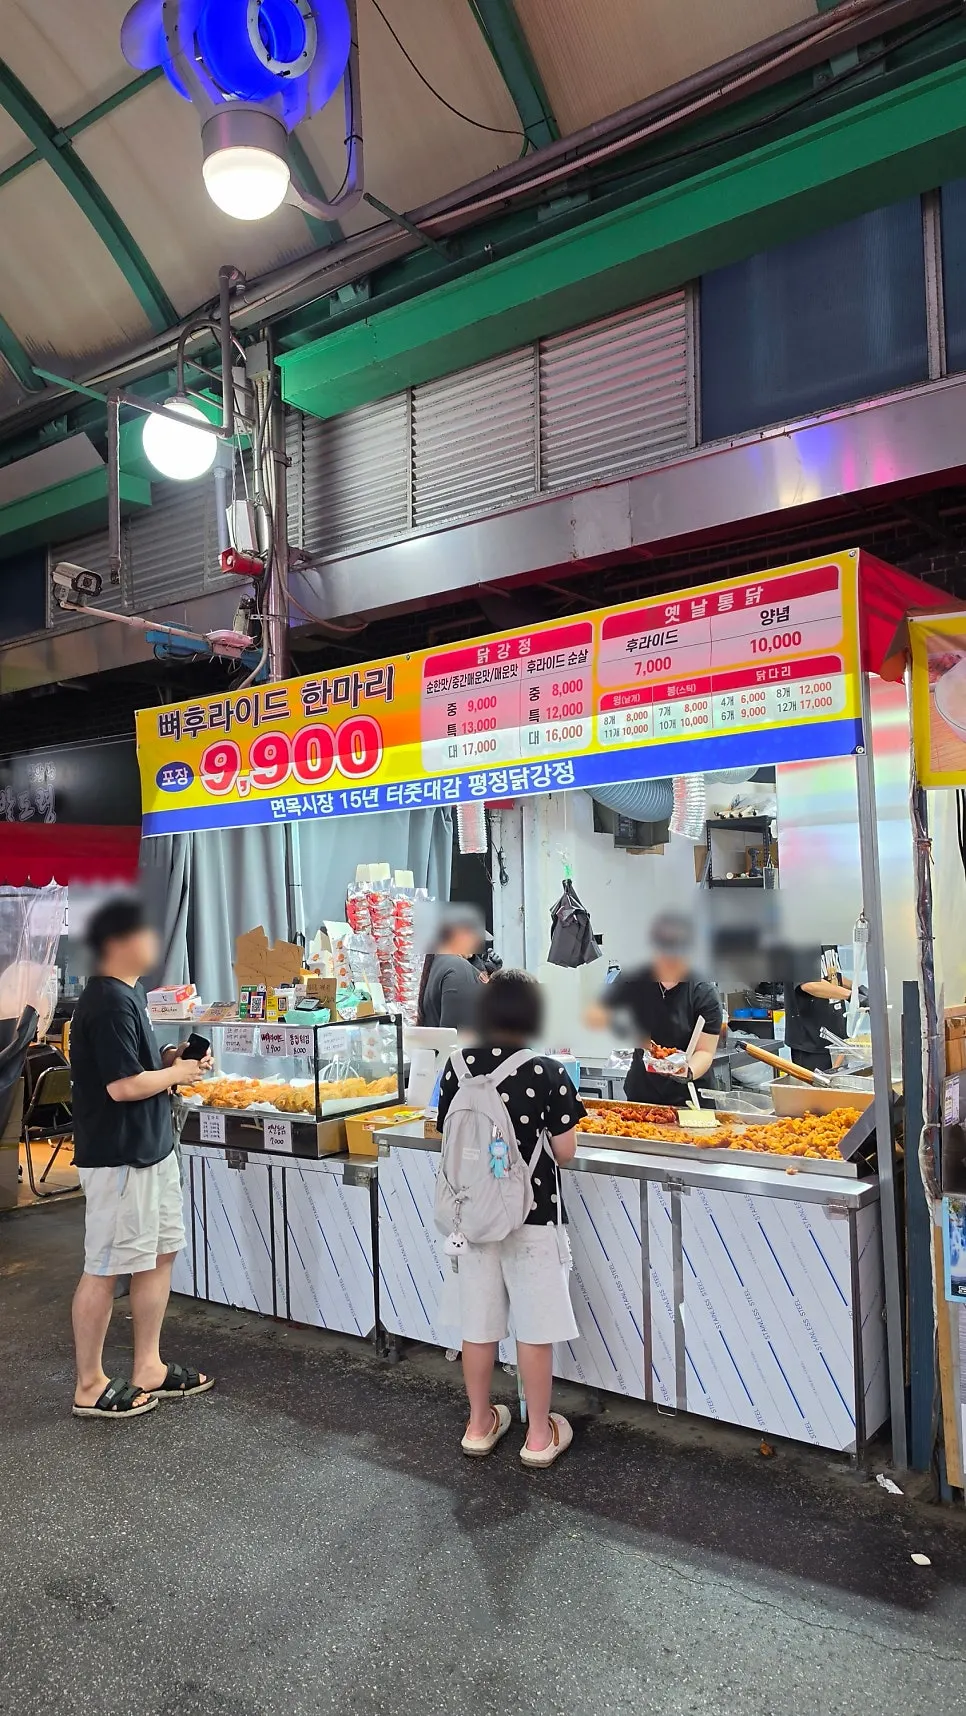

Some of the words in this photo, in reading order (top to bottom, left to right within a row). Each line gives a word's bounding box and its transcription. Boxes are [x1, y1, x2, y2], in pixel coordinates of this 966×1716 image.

[760, 605, 790, 626] 양념
[626, 629, 678, 652] 후라이드
[750, 631, 802, 653] 10,000
[527, 654, 565, 674] 후라이드
[568, 649, 588, 667] 순살
[634, 656, 672, 677] 7,000
[426, 664, 518, 694] 순한맛/중간매운맛/매운맛
[756, 666, 791, 681] 닭다리
[529, 686, 540, 702] 중
[552, 679, 583, 697] 8,000
[667, 684, 697, 697] 봉(스틱)
[721, 696, 734, 707] 4개
[741, 692, 766, 704] 6,000
[776, 687, 790, 699] 8개
[799, 682, 832, 695] 12,000
[158, 688, 291, 741] 뼈후라이드
[301, 663, 395, 717] 한마리
[447, 702, 457, 717] 중
[467, 696, 497, 712] 9,000
[659, 706, 671, 717] 7개
[684, 701, 708, 713] 8,000
[777, 701, 797, 712] 12개
[800, 697, 833, 709] 17,000
[529, 708, 540, 723] 특
[546, 702, 583, 720] 12,000
[604, 715, 616, 725] 8개
[626, 711, 648, 722] 8,000
[721, 710, 734, 721] 6개
[741, 706, 766, 718] 9,000
[462, 718, 497, 735] 13,000
[604, 728, 620, 738] 11개
[623, 724, 648, 736] 10,000
[660, 720, 677, 730] 10개
[681, 715, 708, 727] 10,000
[529, 730, 540, 745] 대
[545, 724, 583, 742] 16,000
[199, 714, 384, 798] 9,900
[448, 744, 458, 758] 대
[462, 739, 497, 756] 17,000
[161, 767, 189, 786] 포장
[270, 793, 334, 819] 면목시장
[339, 787, 380, 809] 15년
[386, 776, 462, 805] 터줏대감
[468, 760, 575, 796] 평정닭강정
[608, 1263, 619, 1280] STEEL
[652, 1271, 661, 1288] STEEL
[616, 1280, 632, 1310] STAINLESS
[697, 1280, 707, 1297] STEEL
[744, 1288, 755, 1307] STEEL
[660, 1289, 675, 1320] STAINLESS
[704, 1298, 721, 1329] STAINLESS
[794, 1299, 806, 1317] STEEL
[752, 1308, 771, 1340] STAINLESS
[802, 1318, 822, 1351] STAINLESS
[660, 1383, 670, 1402] STEEL
[705, 1396, 717, 1414] STEEL
[754, 1409, 765, 1427] STEEL
[804, 1421, 817, 1439] STEEL
